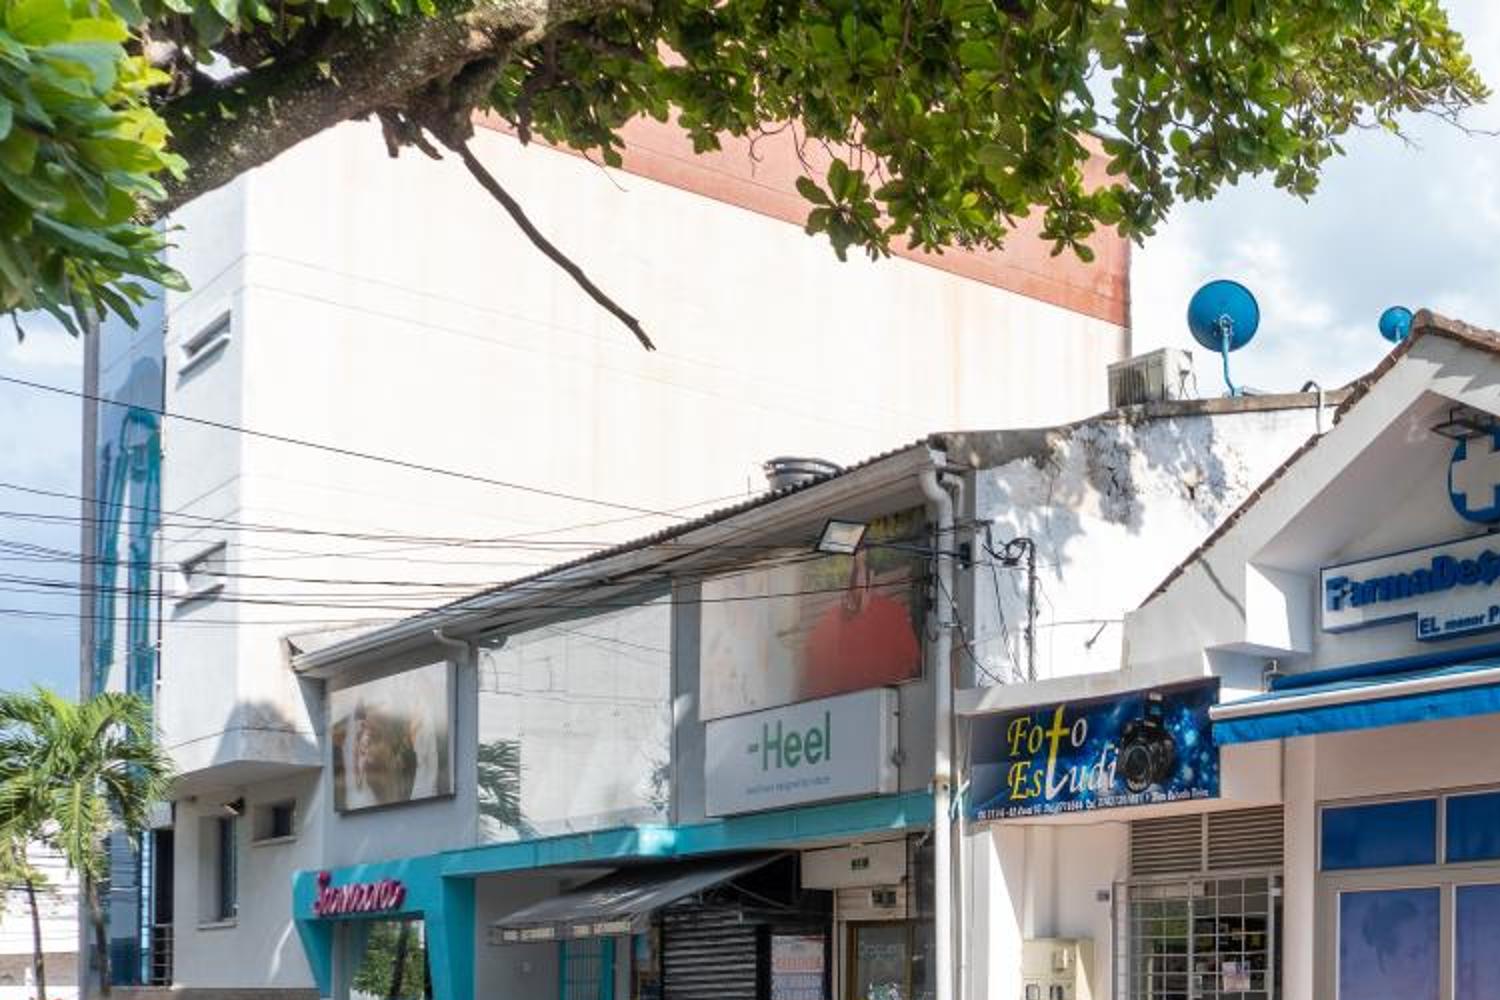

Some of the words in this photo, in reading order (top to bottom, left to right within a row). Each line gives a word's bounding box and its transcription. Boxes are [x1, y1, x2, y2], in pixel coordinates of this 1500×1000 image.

[1419, 617, 1440, 635] EL
[1445, 613, 1485, 631] menor
[763, 710, 831, 771] Heel
[1007, 703, 1088, 758] Foto
